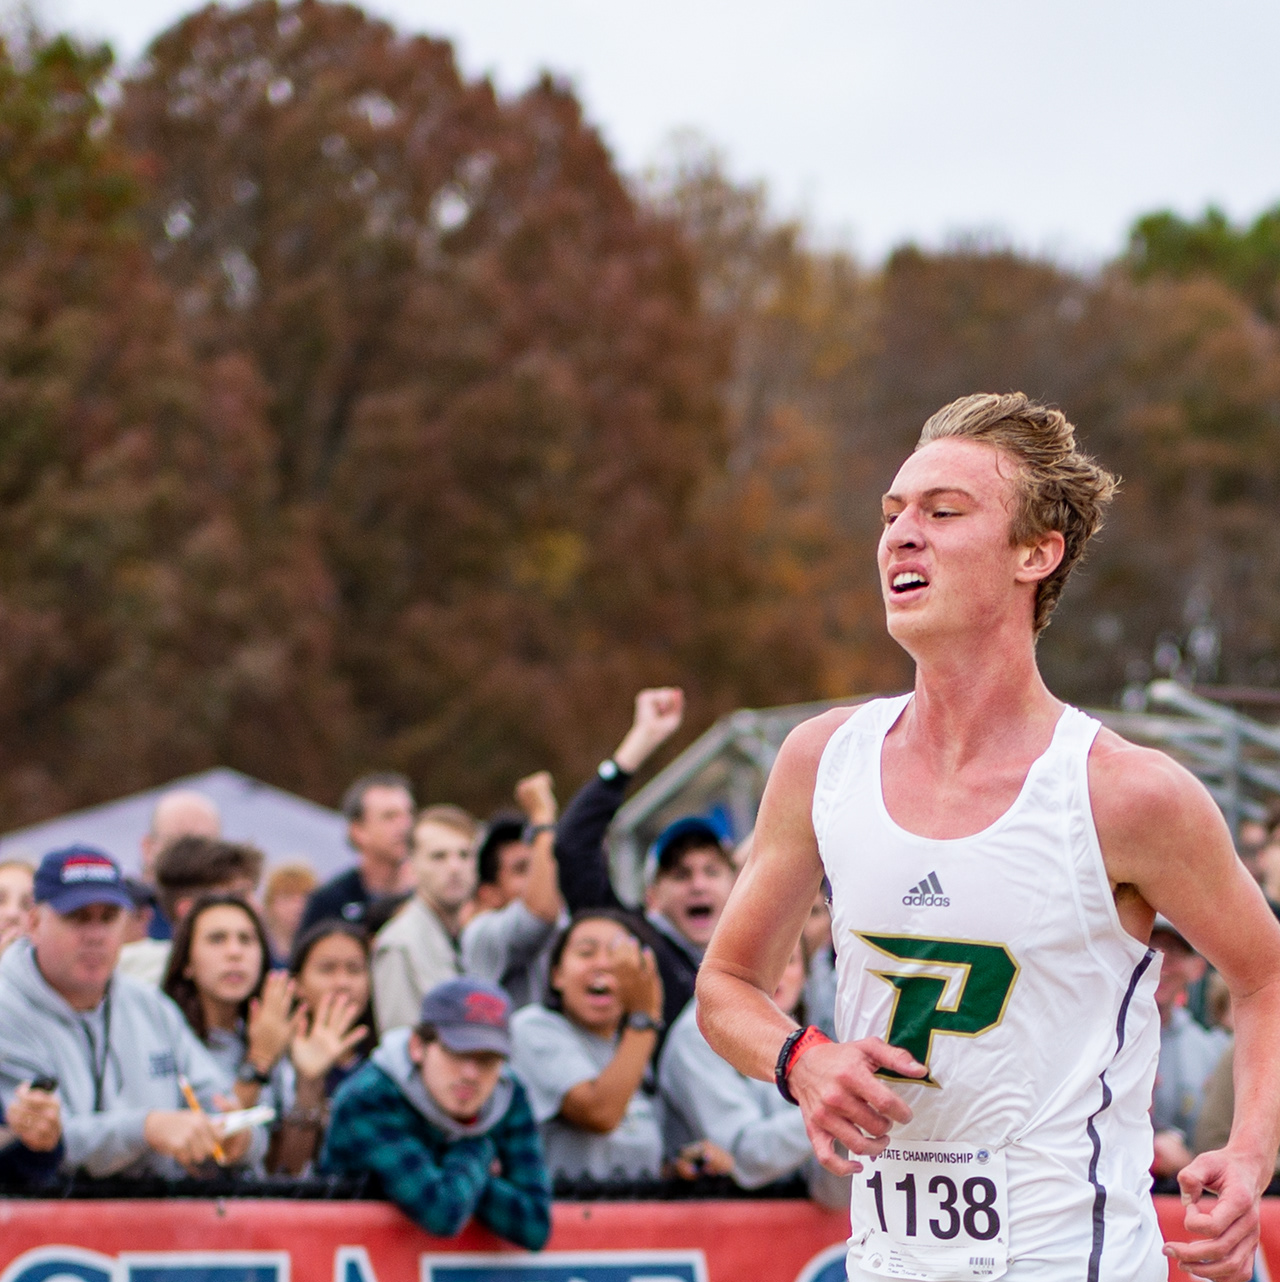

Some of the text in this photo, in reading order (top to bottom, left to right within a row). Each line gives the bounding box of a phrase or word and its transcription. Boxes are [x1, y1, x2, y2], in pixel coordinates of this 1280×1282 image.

[902, 894, 951, 907] adidas
[848, 929, 1022, 1090] P
[902, 1150, 974, 1164] CHAMPIONSHIP
[866, 1170, 1001, 1241] 1138
